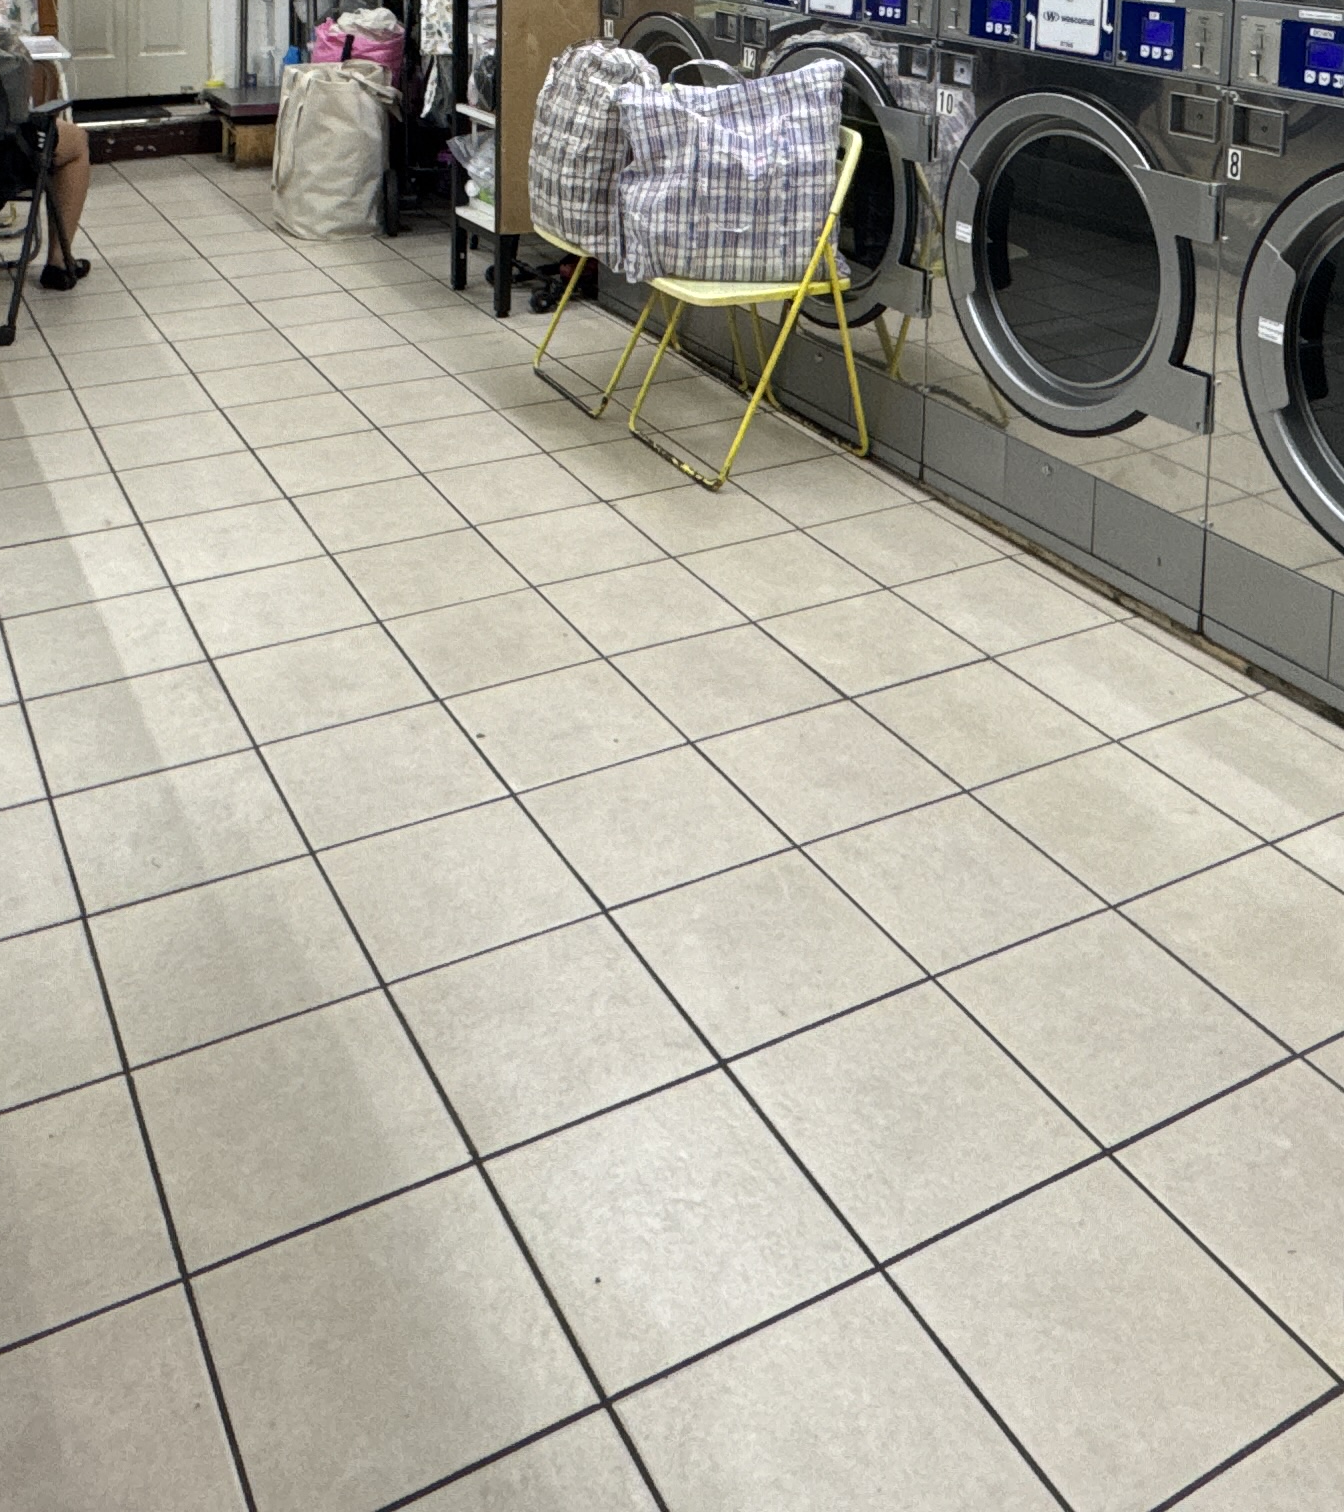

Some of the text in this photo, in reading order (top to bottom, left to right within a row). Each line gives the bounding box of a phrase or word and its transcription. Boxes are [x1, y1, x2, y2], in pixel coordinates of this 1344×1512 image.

[1061, 14, 1095, 27] wascomat
[744, 49, 755, 68] 12
[940, 94, 953, 114] 10
[1230, 152, 1239, 177] 8
